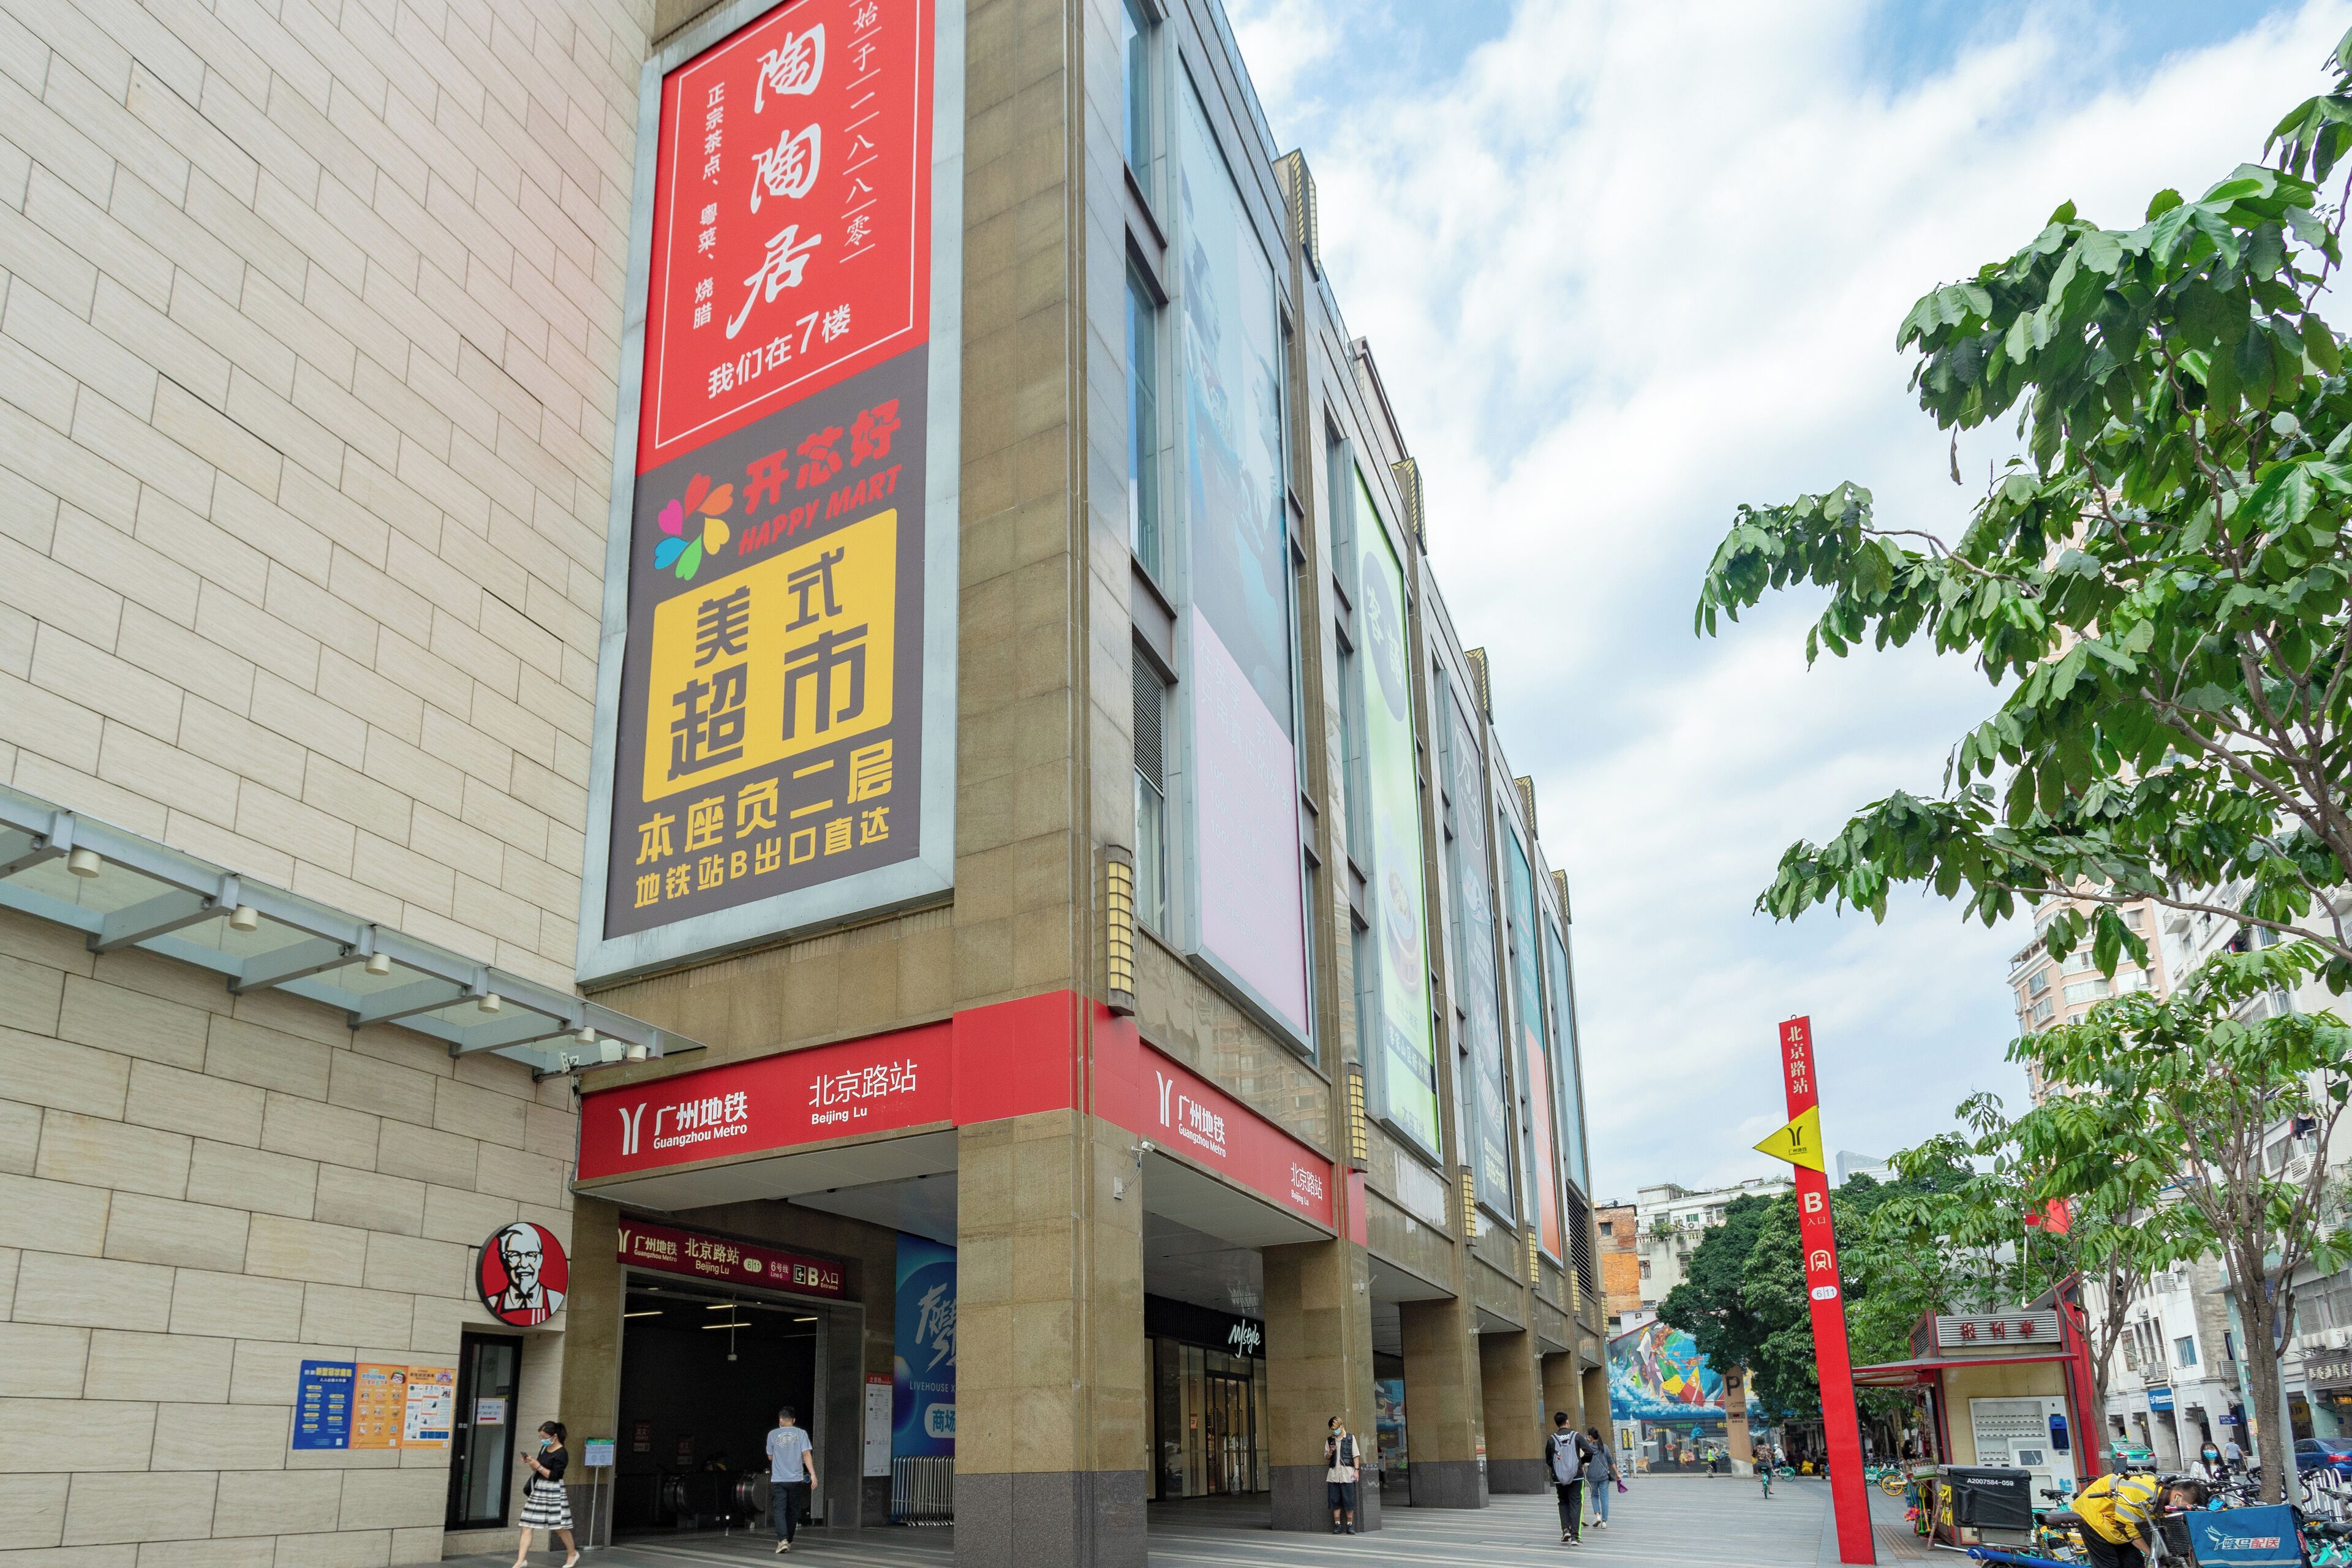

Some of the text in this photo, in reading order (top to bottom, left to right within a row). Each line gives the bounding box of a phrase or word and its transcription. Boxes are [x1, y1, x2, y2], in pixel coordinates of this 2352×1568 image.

[726, 22, 825, 339] 陶陶居
[708, 303, 851, 399] 我们在7楼
[743, 398, 901, 516] 开芯好
[737, 465, 903, 556] HAPPY MART
[694, 545, 845, 669] 美式
[666, 622, 868, 782] 超市
[635, 739, 892, 865] 本座负二层
[634, 807, 889, 908] 地铁站B出口直达
[1787, 1025, 1809, 1095] 北京路站
[809, 1058, 918, 1108] 北京路站
[653, 1091, 748, 1136] 广州地铁
[811, 1105, 867, 1125] Beijing Lu
[1177, 1093, 1226, 1145] 广州地铁
[653, 1123, 748, 1150] Guangzhou Metro
[1178, 1123, 1226, 1159] Guangzhou Metro
[1290, 1161, 1323, 1201] 北京路站
[1291, 1188, 1310, 1207] Beijing Lu
[1803, 1191, 1823, 1213] B
[1807, 1217, 1826, 1226] 入口
[634, 1235, 678, 1256] 广州地铁
[634, 1248, 677, 1263] Guangzhou Metro
[684, 1237, 740, 1265] 北京路站
[695, 1259, 729, 1275] Beijing Lu
[771, 1261, 789, 1275] 6号线
[808, 1267, 819, 1287] B
[821, 1270, 839, 1285] 入口
[1960, 1319, 2035, 1341] 报刊亭
[910, 1381, 949, 1392] LIVEHOUSE
[1726, 1376, 1740, 1396] P
[1967, 1477, 2014, 1487] A2007584-059
[2223, 1537, 2280, 1548] 蜂鸟配送
